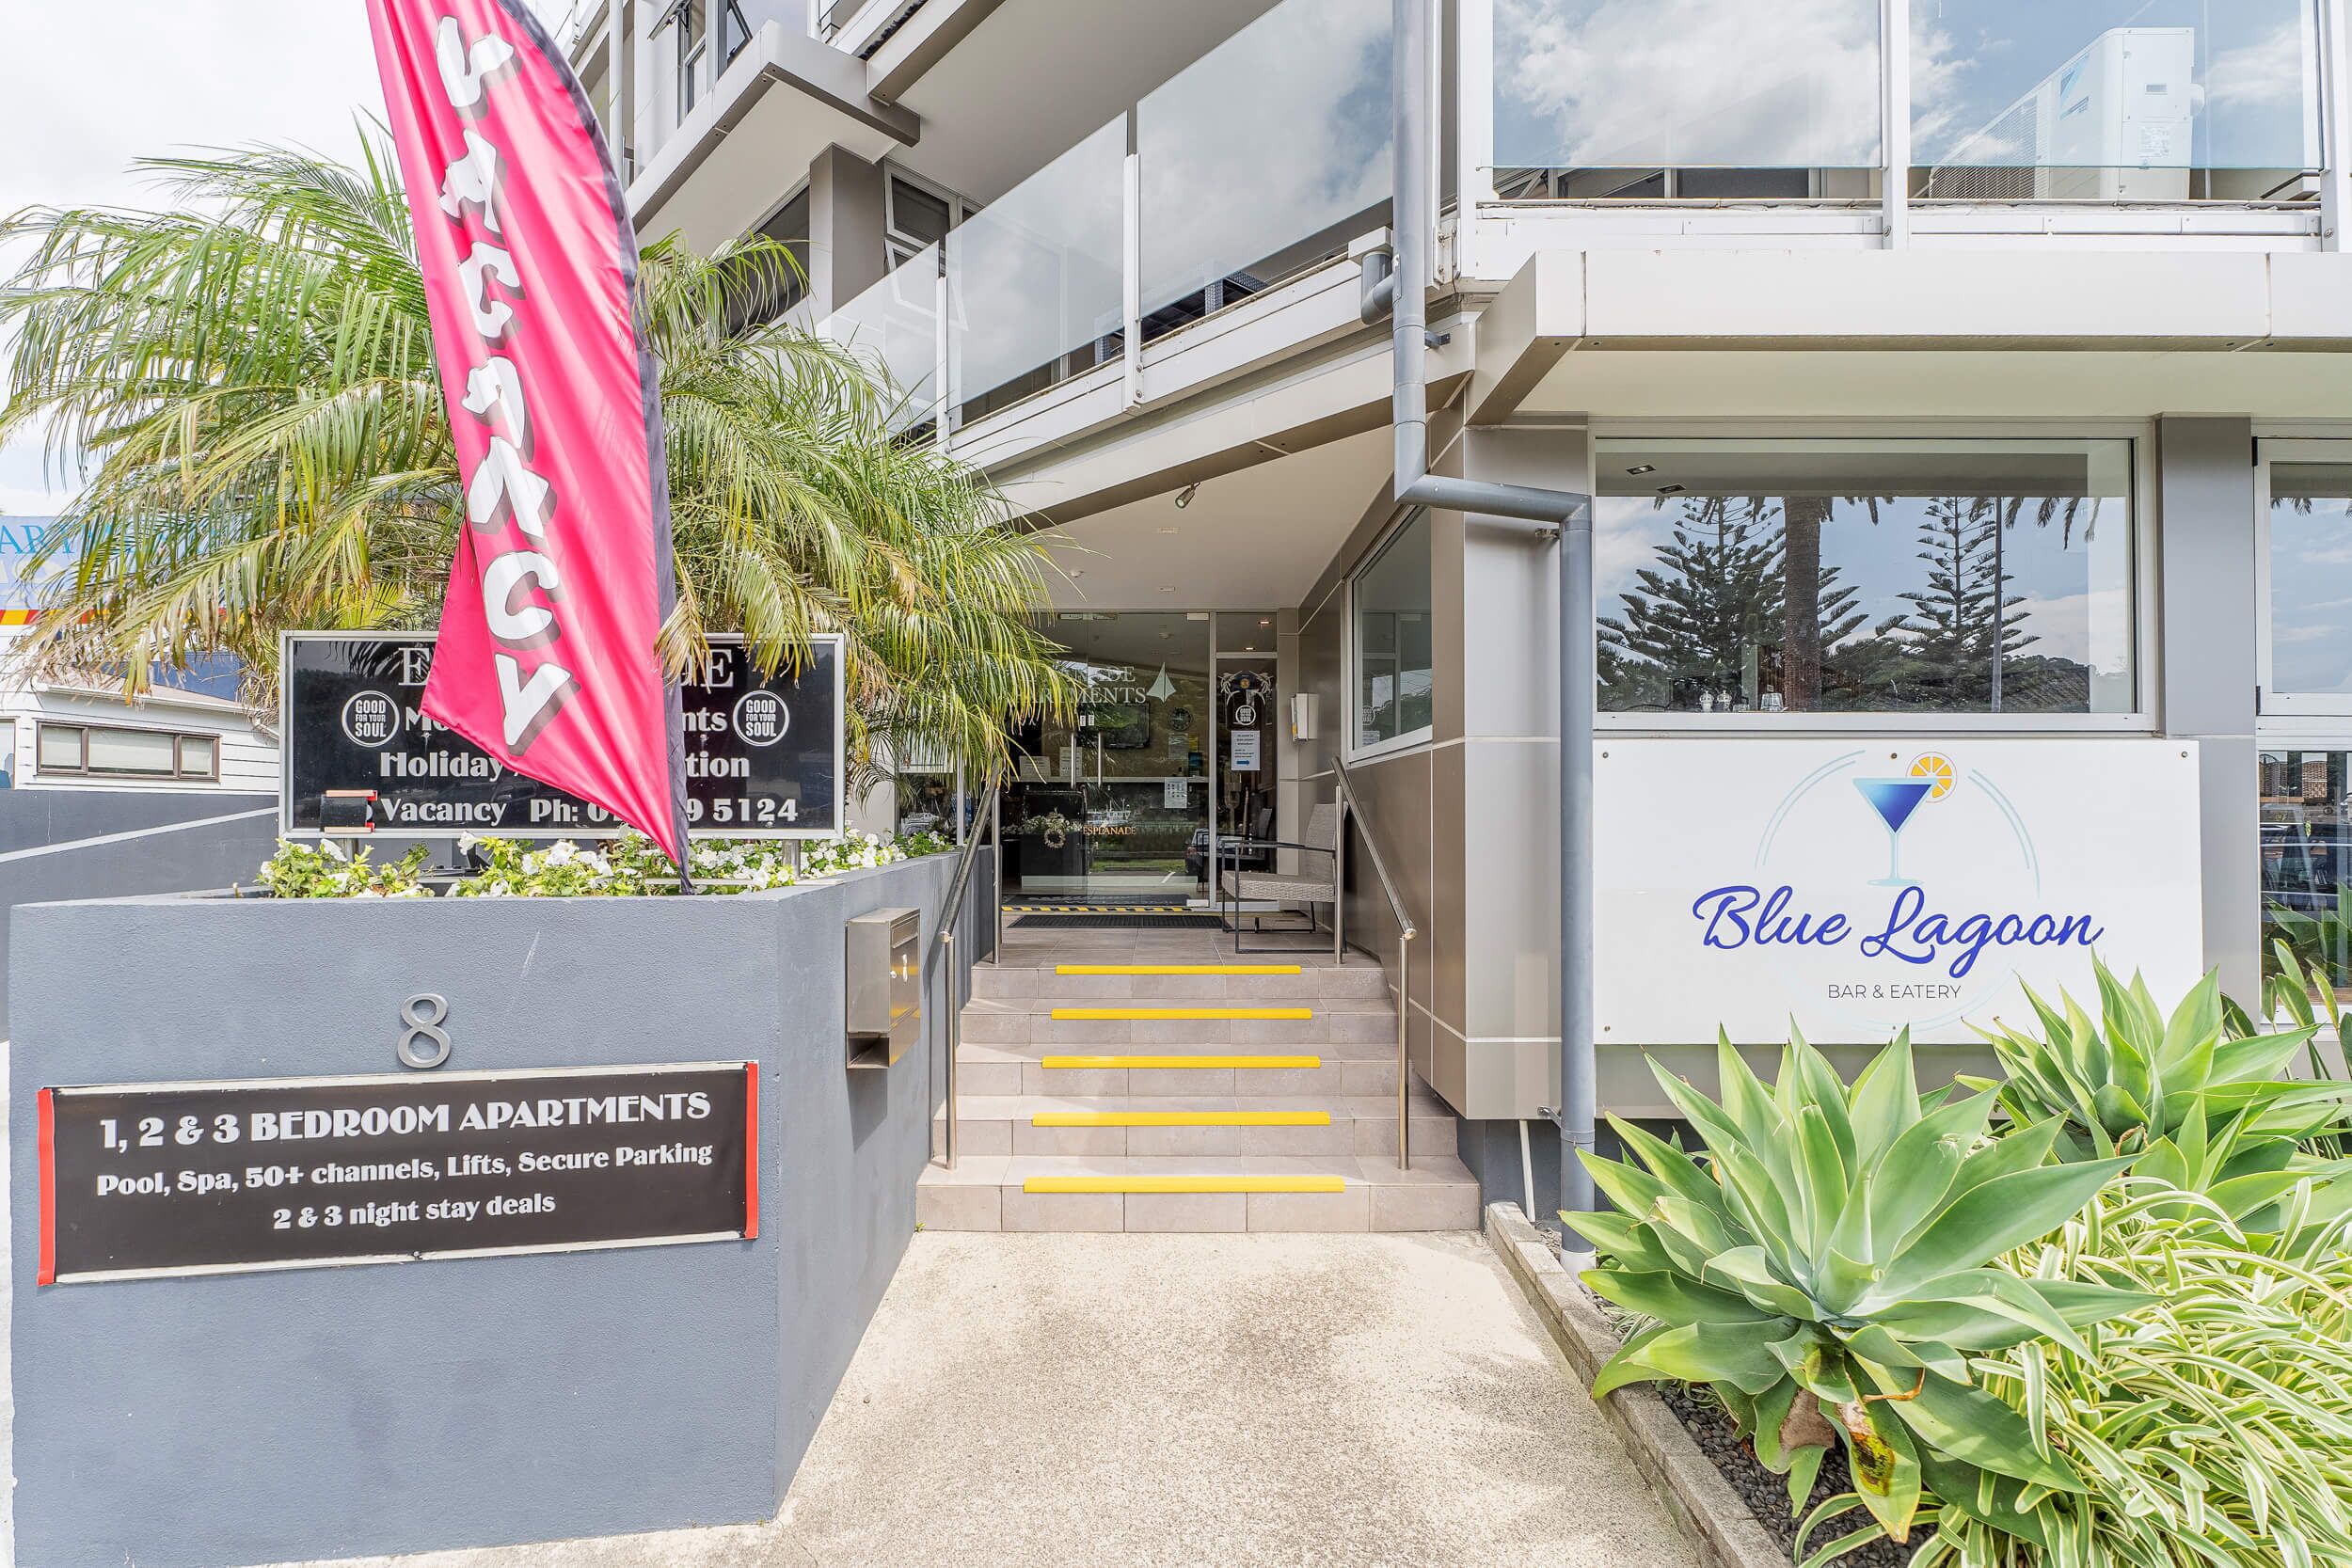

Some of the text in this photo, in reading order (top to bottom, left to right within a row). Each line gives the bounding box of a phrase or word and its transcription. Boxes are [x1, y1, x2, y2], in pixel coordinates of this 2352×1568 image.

[356, 700, 386, 713] GOOD
[746, 700, 776, 713] GOOD
[356, 722, 387, 737] SOUL
[746, 722, 777, 737] SOUL
[380, 750, 503, 782] Holiday
[381, 798, 507, 827] Vacancy
[531, 799, 578, 821] Ph:
[713, 799, 798, 822] 5124
[1692, 885, 2105, 978] Blue Lagoon
[1828, 984, 1961, 999] BAR & EATERY
[396, 992, 453, 1069] 8
[100, 1092, 711, 1152] 1, 2 & 3 BEDROOM APARTMENTS
[97, 1143, 712, 1196] Pool, Spa, 50+ channels, Lifts, Secure Parking
[273, 1194, 556, 1229] 2 & 3 night stay deals
